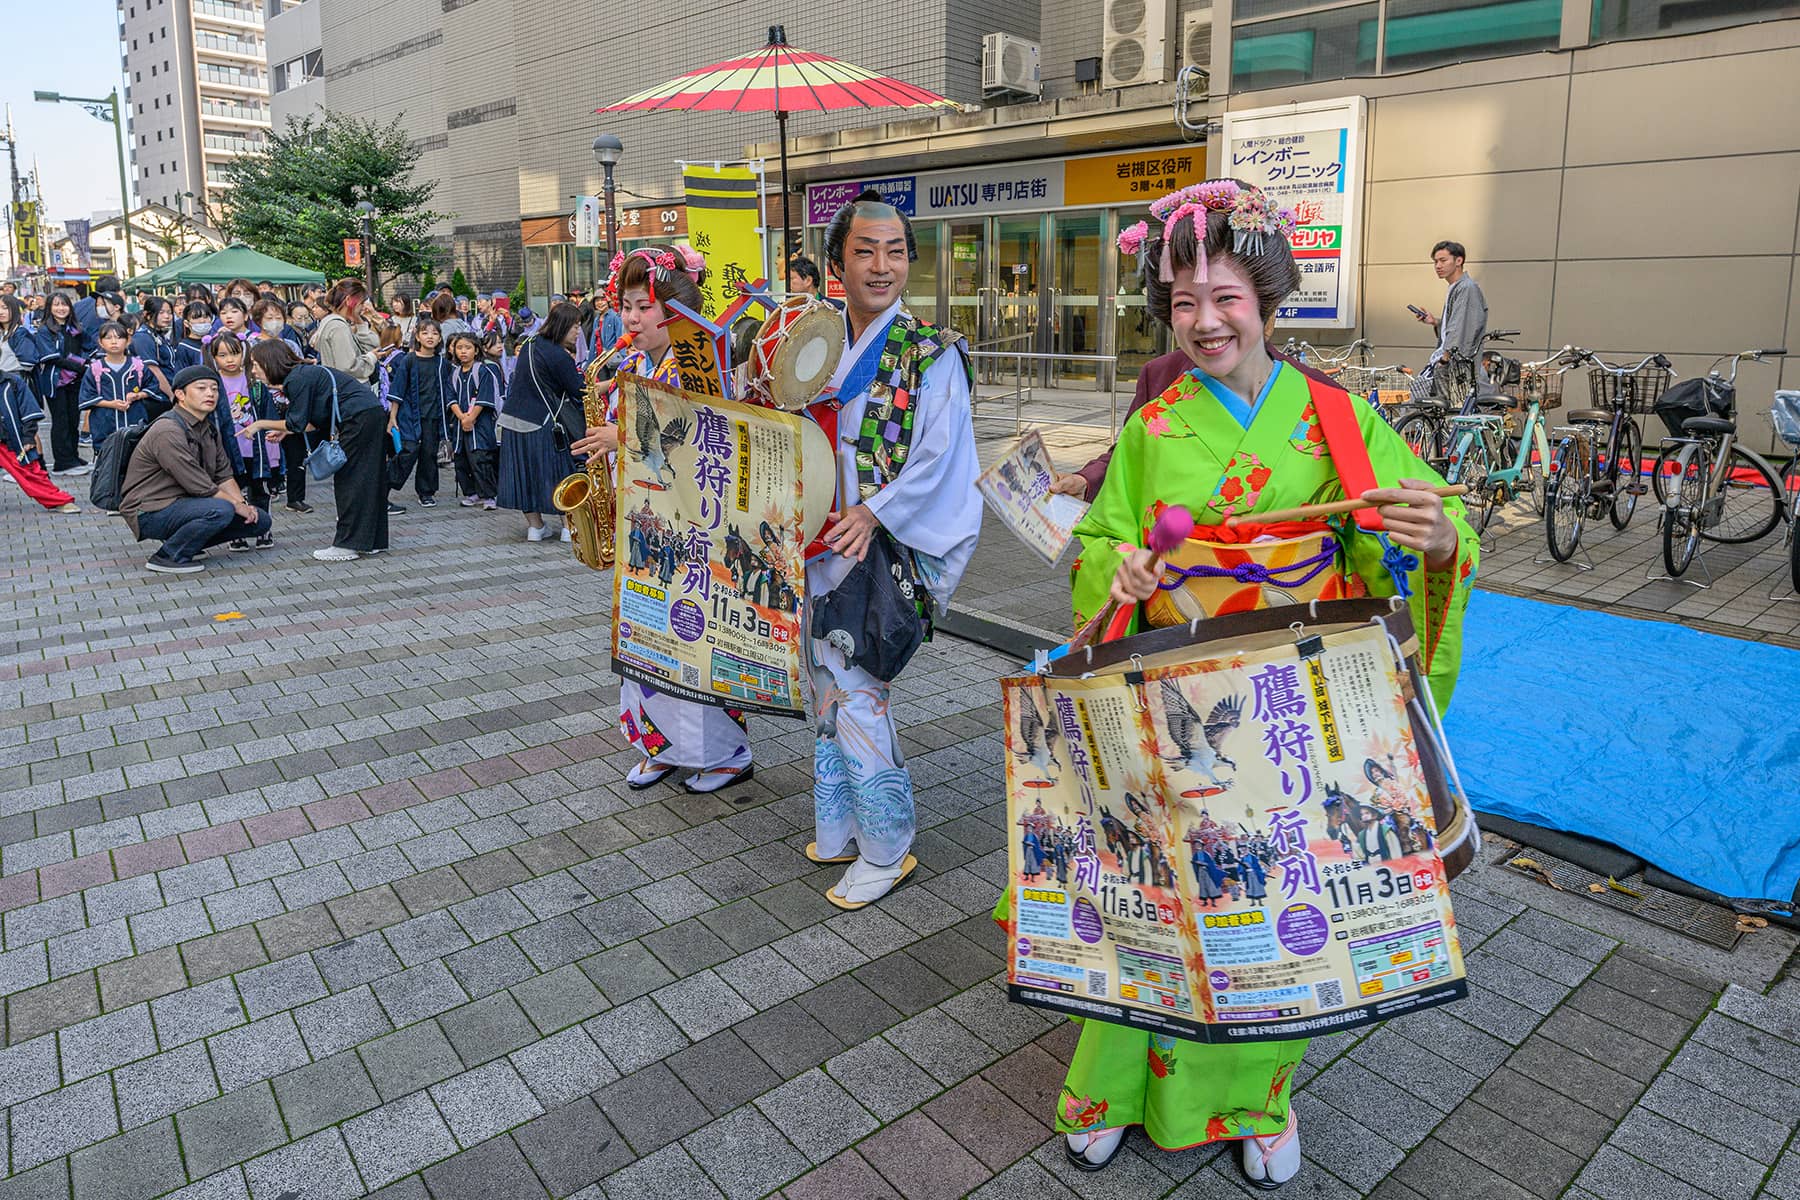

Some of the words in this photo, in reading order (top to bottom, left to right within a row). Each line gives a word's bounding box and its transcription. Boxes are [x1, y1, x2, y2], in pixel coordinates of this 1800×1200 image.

[1117, 156, 1192, 178] 岩槻区役所
[1233, 146, 1310, 166] レインボー
[1267, 162, 1342, 181] クリニック
[812, 186, 853, 201] レインボー
[930, 183, 979, 208] WATSU
[981, 178, 1047, 202] 専門店街
[1288, 229, 1335, 247] ゼリヤ
[1285, 308, 1298, 318] 4F
[682, 406, 734, 602] 鷹狩り行列
[626, 579, 666, 602] 参加者募集
[712, 582, 742, 599] 令和6年
[710, 593, 771, 637] 11月3日
[1249, 663, 1322, 900] 鷹狩り行列
[1054, 691, 1102, 895] 鷹狩り行列
[1322, 860, 1363, 876] 令和6年
[1324, 867, 1412, 908] 11月3日
[1101, 885, 1158, 922] 11月3日
[1204, 910, 1265, 928] 参加者募集
